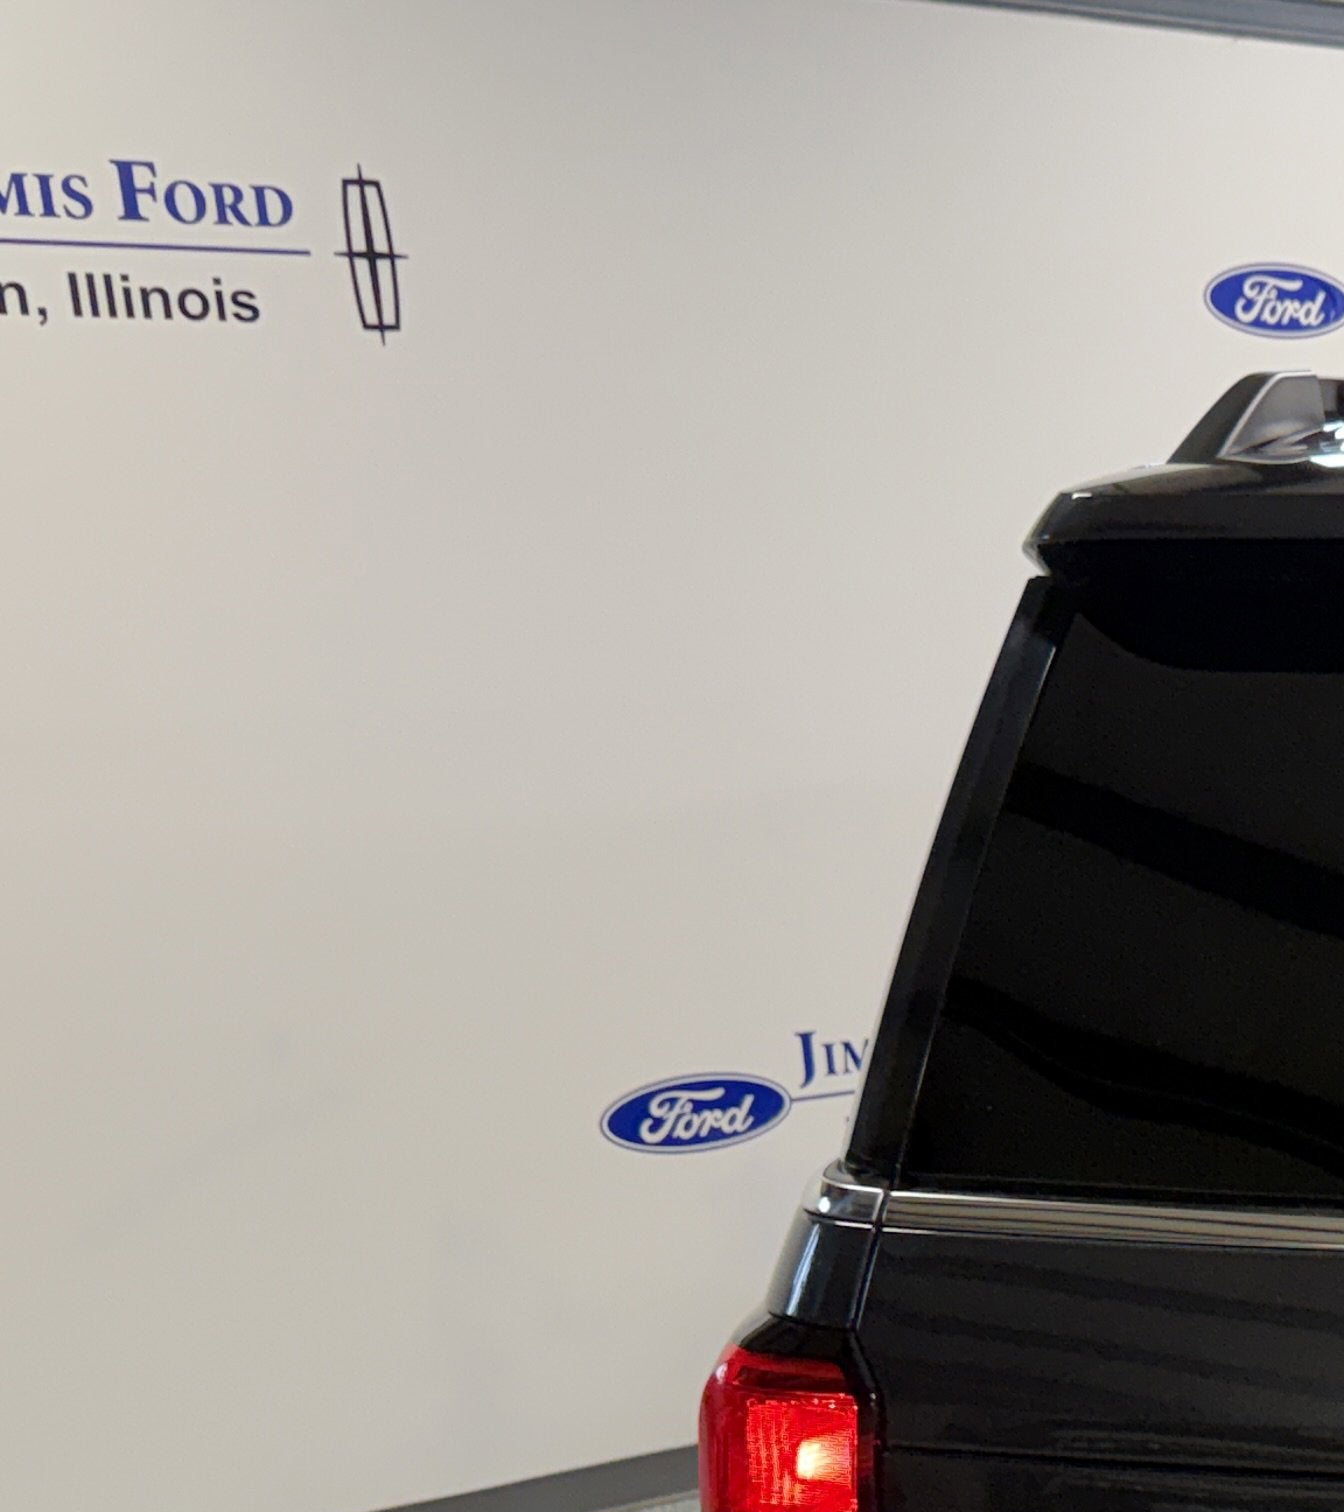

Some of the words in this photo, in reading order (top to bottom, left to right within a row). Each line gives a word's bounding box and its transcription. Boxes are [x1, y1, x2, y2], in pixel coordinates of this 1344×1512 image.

[110, 159, 294, 228] FORD
[67, 271, 261, 323] Illinois
[1233, 273, 1327, 328] Ford
[638, 1086, 754, 1145] Ford
